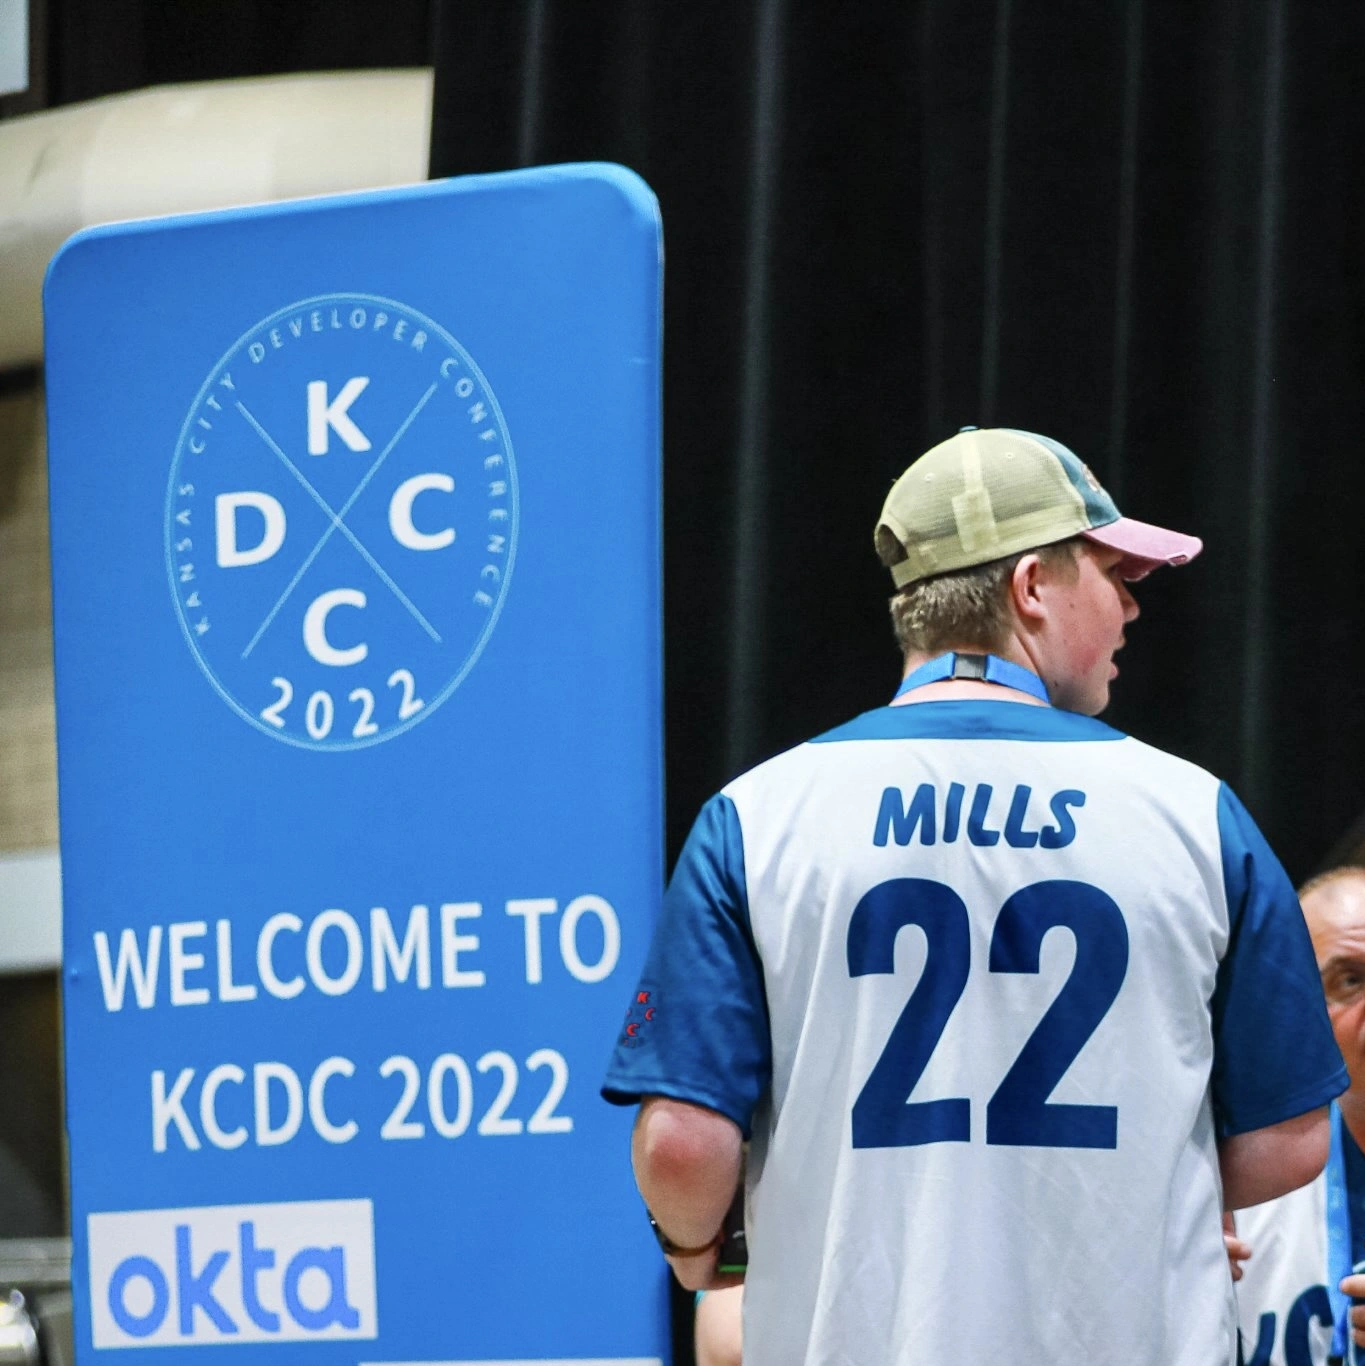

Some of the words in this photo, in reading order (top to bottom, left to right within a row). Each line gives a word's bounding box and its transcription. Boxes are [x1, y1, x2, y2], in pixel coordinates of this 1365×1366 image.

[248, 308, 428, 364] DEVELOPER
[189, 372, 236, 454] CITY
[307, 376, 372, 456] K
[215, 491, 287, 568] D
[388, 473, 456, 551] C
[440, 357, 508, 608] CONFERENCE
[176, 484, 211, 636] KANSAS
[303, 588, 368, 666] C
[261, 669, 425, 739] 2022
[872, 782, 1086, 849] MILLS
[94, 902, 486, 1012] WELCOME
[506, 895, 621, 984] TO
[846, 877, 1130, 1150] 22
[151, 1056, 359, 1152] KCDC
[379, 1049, 573, 1140] 2022
[107, 1220, 360, 1337] okta
